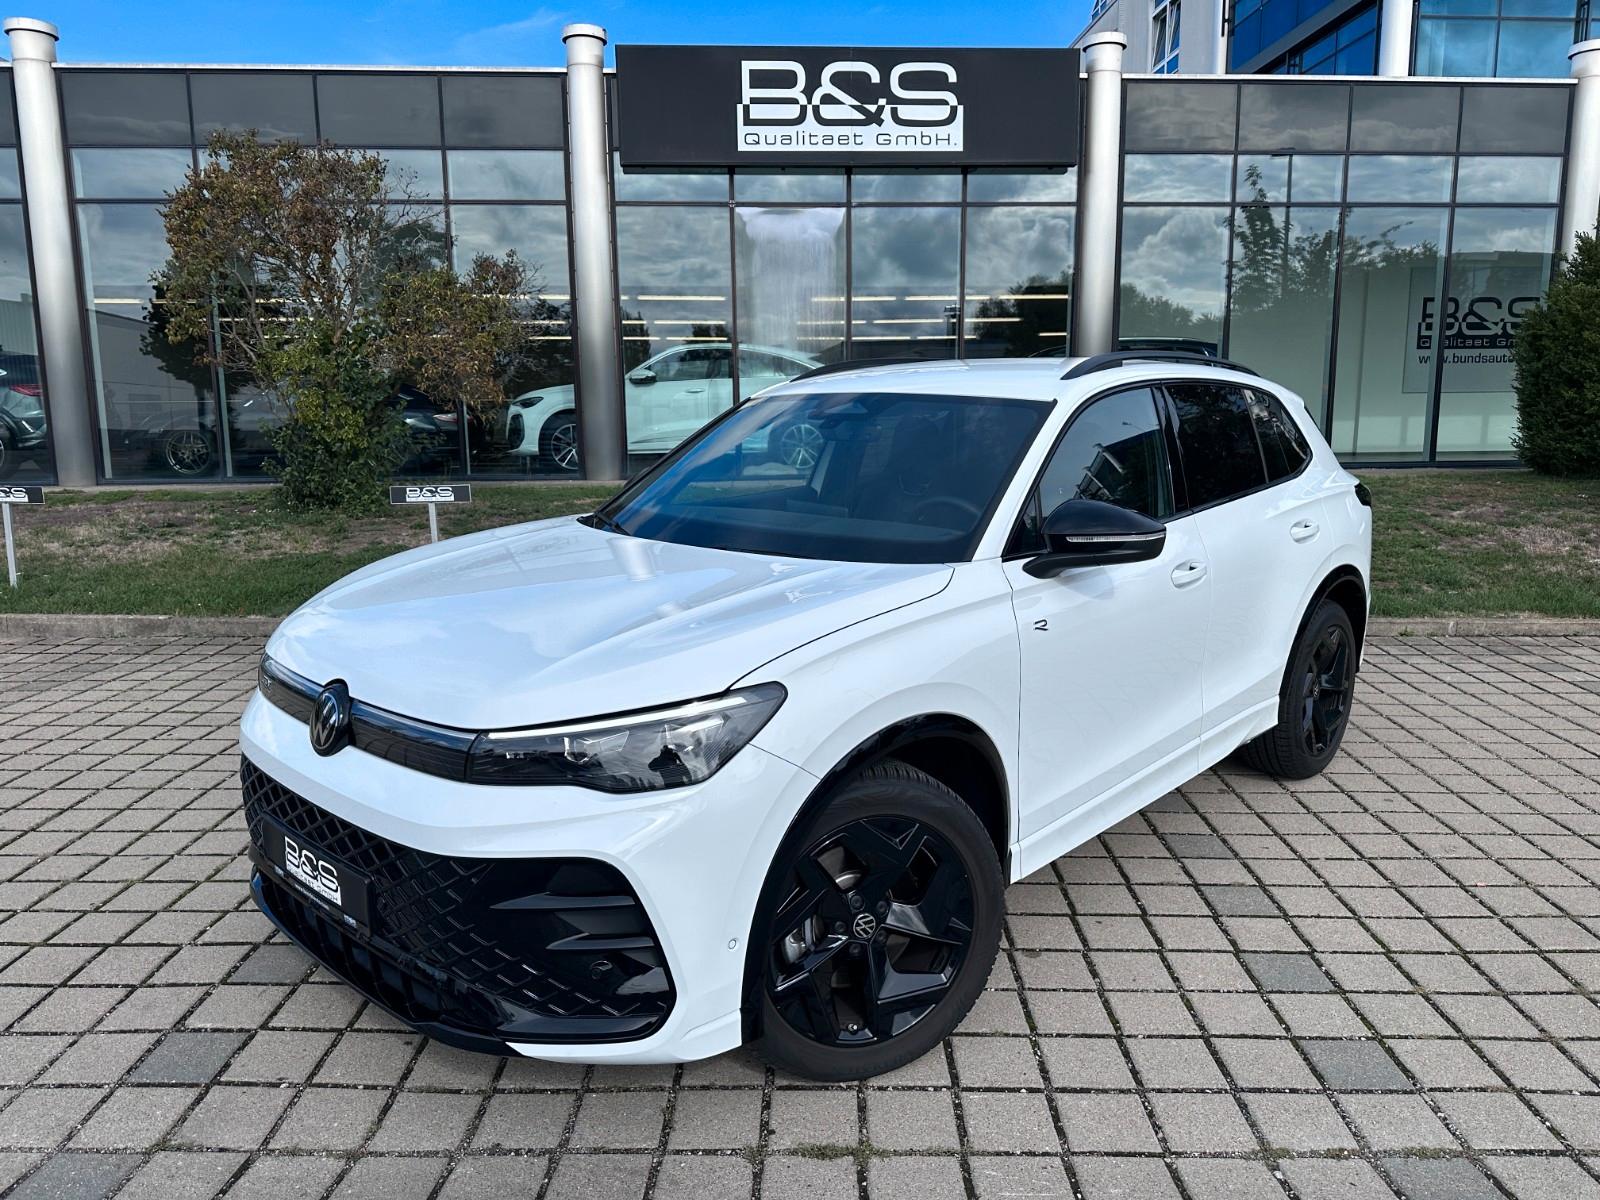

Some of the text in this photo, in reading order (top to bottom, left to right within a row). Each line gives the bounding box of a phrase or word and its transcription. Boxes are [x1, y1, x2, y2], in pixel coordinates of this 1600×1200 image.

[741, 60, 958, 127] B&S
[744, 131, 958, 146] Qualitaet GmbH.
[1420, 337, 1490, 347] Qalitaet
[406, 487, 453, 498] B&S
[285, 836, 339, 893] B&S
